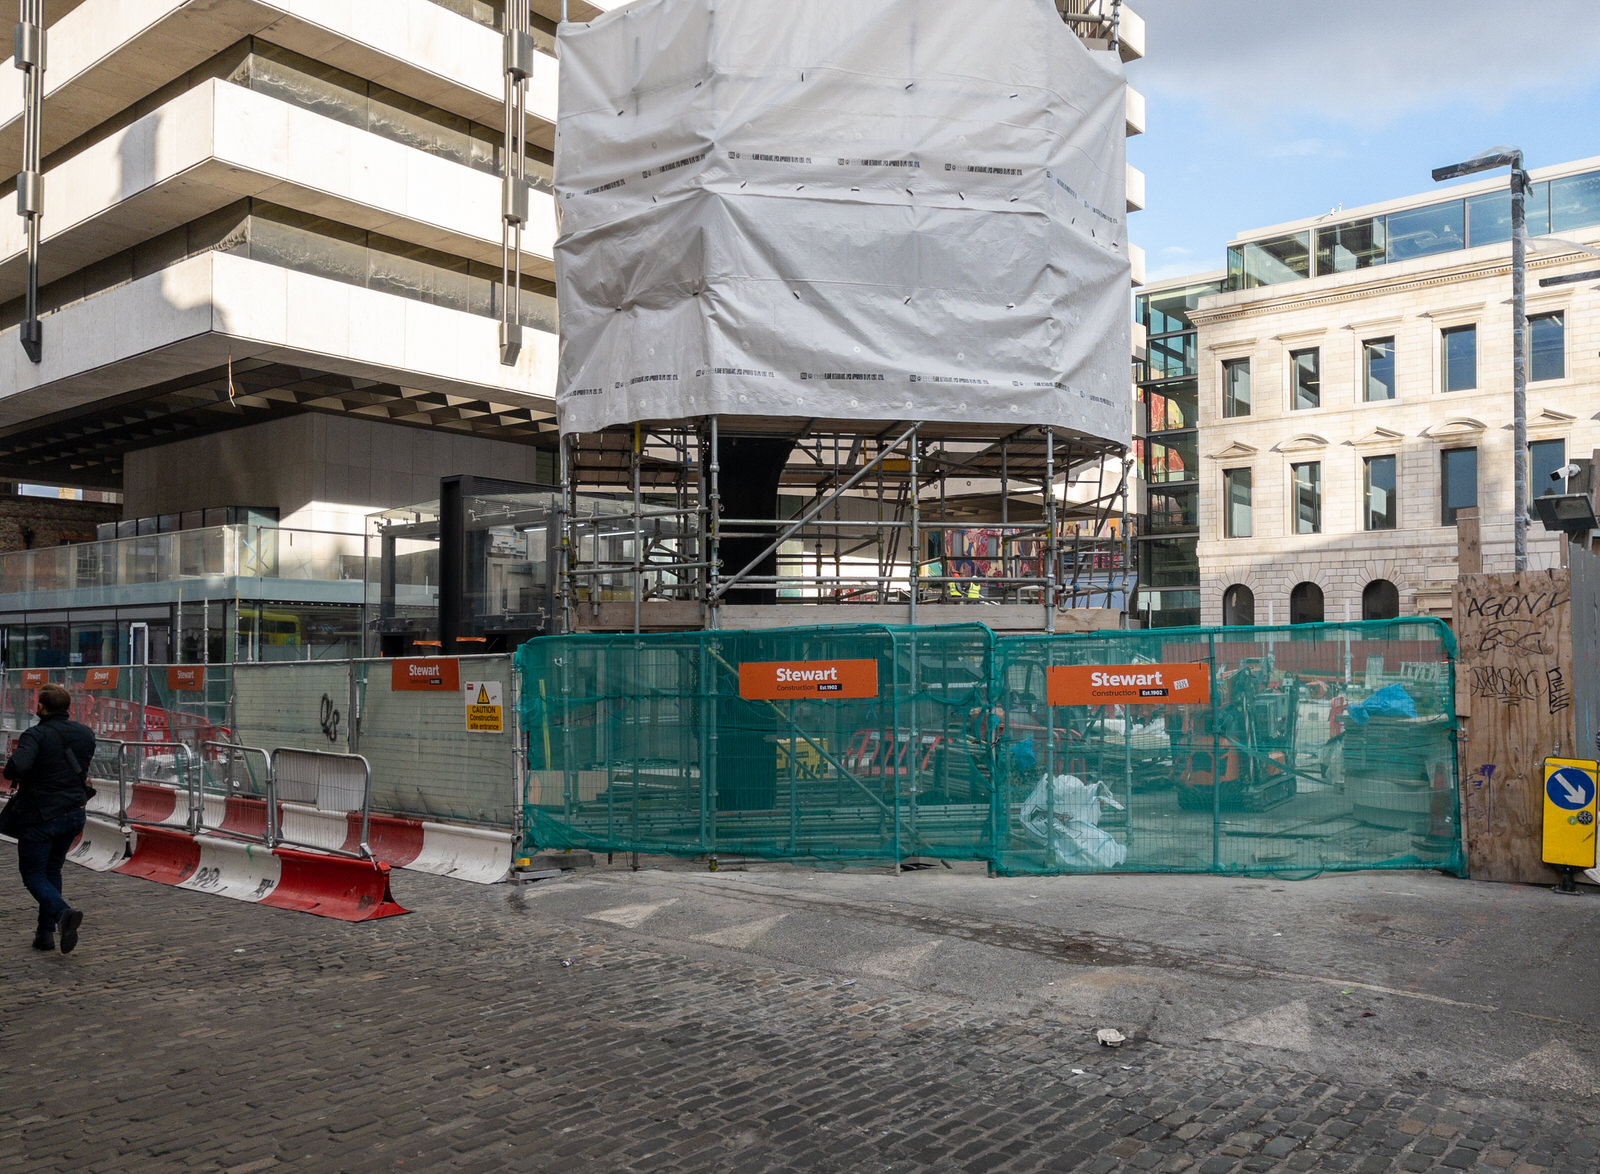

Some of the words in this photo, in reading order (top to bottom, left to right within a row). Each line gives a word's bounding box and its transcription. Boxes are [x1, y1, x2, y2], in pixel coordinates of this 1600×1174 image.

[409, 664, 440, 676] Stewart
[776, 667, 838, 682] Stewart
[1091, 671, 1163, 687] Stewart
[472, 706, 496, 714] CAUTION
[470, 714, 499, 722] Construction
